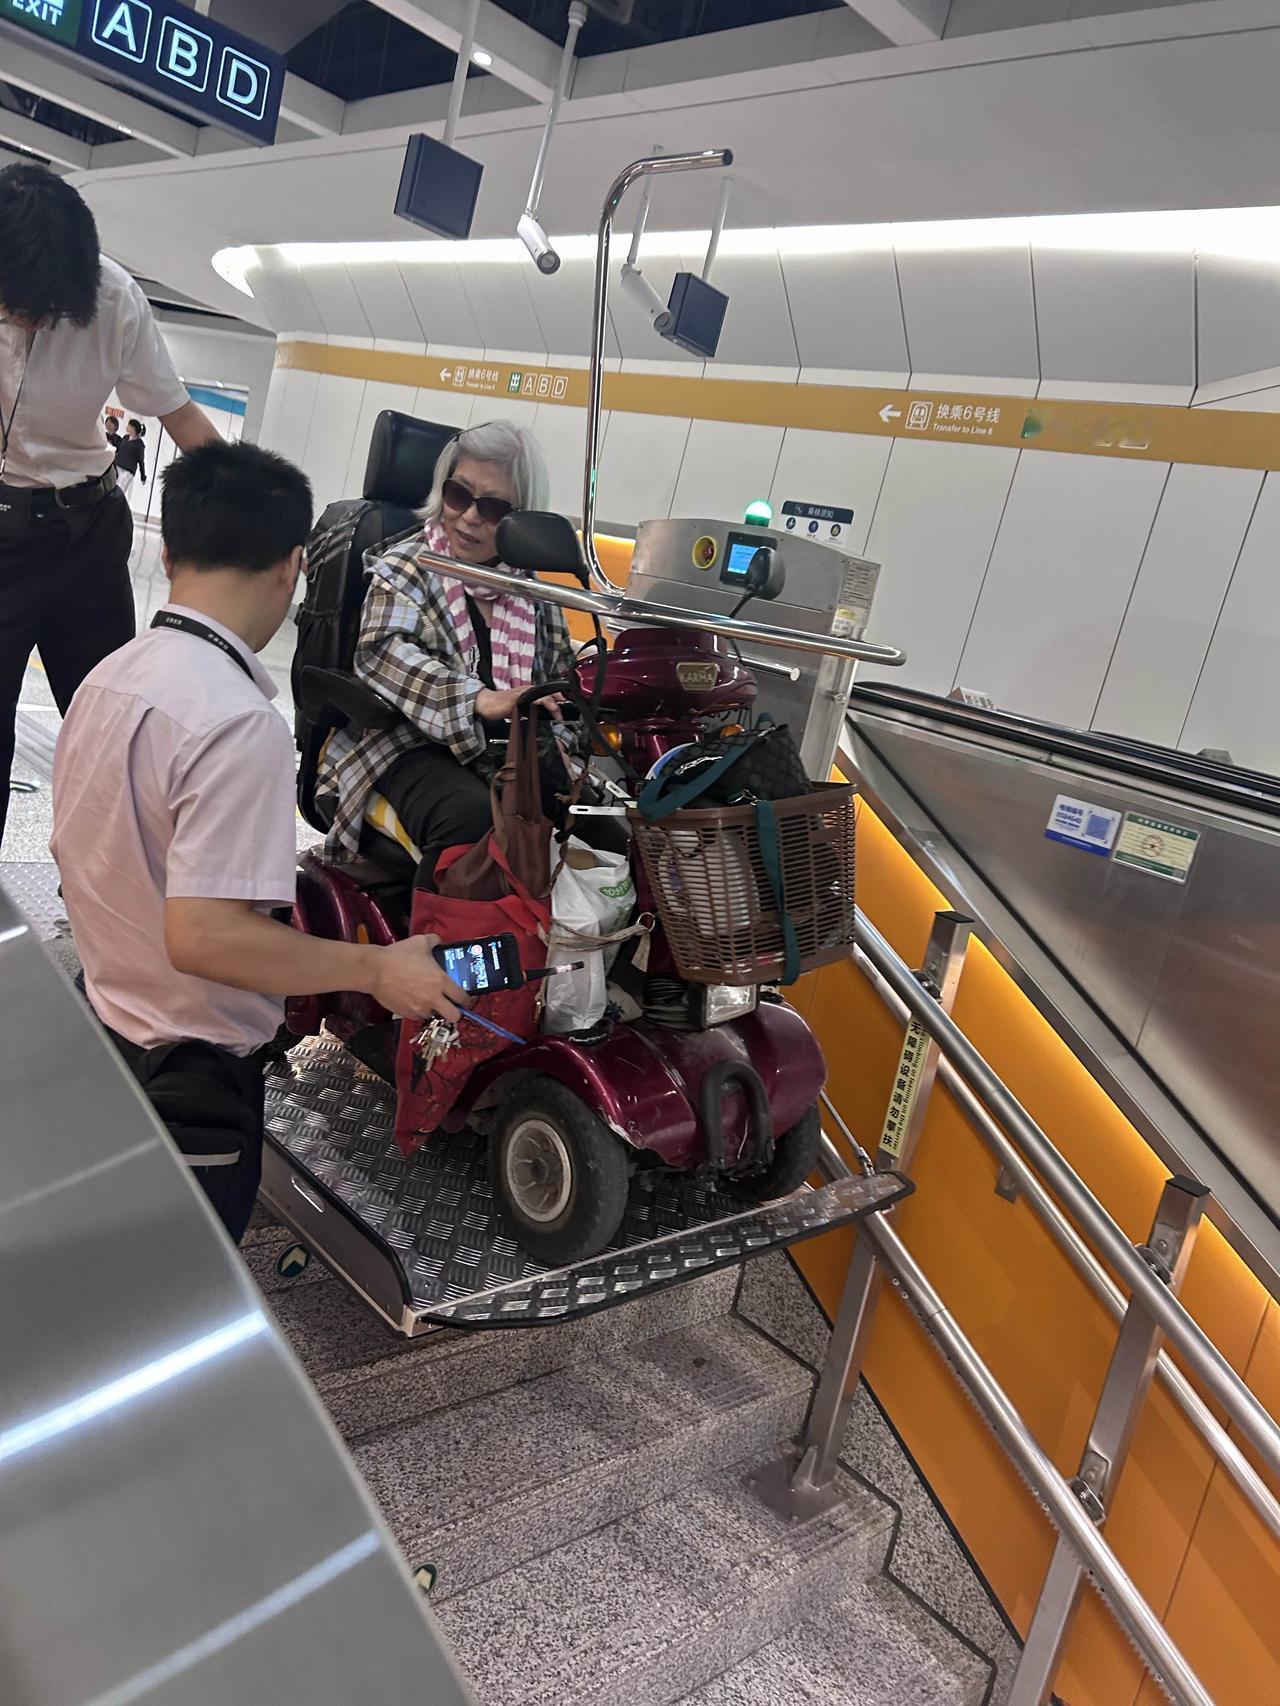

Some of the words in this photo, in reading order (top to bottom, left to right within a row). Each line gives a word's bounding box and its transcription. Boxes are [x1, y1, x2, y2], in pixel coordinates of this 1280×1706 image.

[102, 1, 137, 53] A
[167, 28, 199, 78] B
[226, 57, 258, 106] D
[524, 376, 533, 394] A
[538, 376, 549, 394] B
[554, 379, 565, 396] D
[936, 403, 1001, 424] 换乘6号线
[933, 423, 961, 433] Transfer
[961, 425, 970, 433] to
[970, 425, 987, 435] Line
[987, 427, 993, 436] 6
